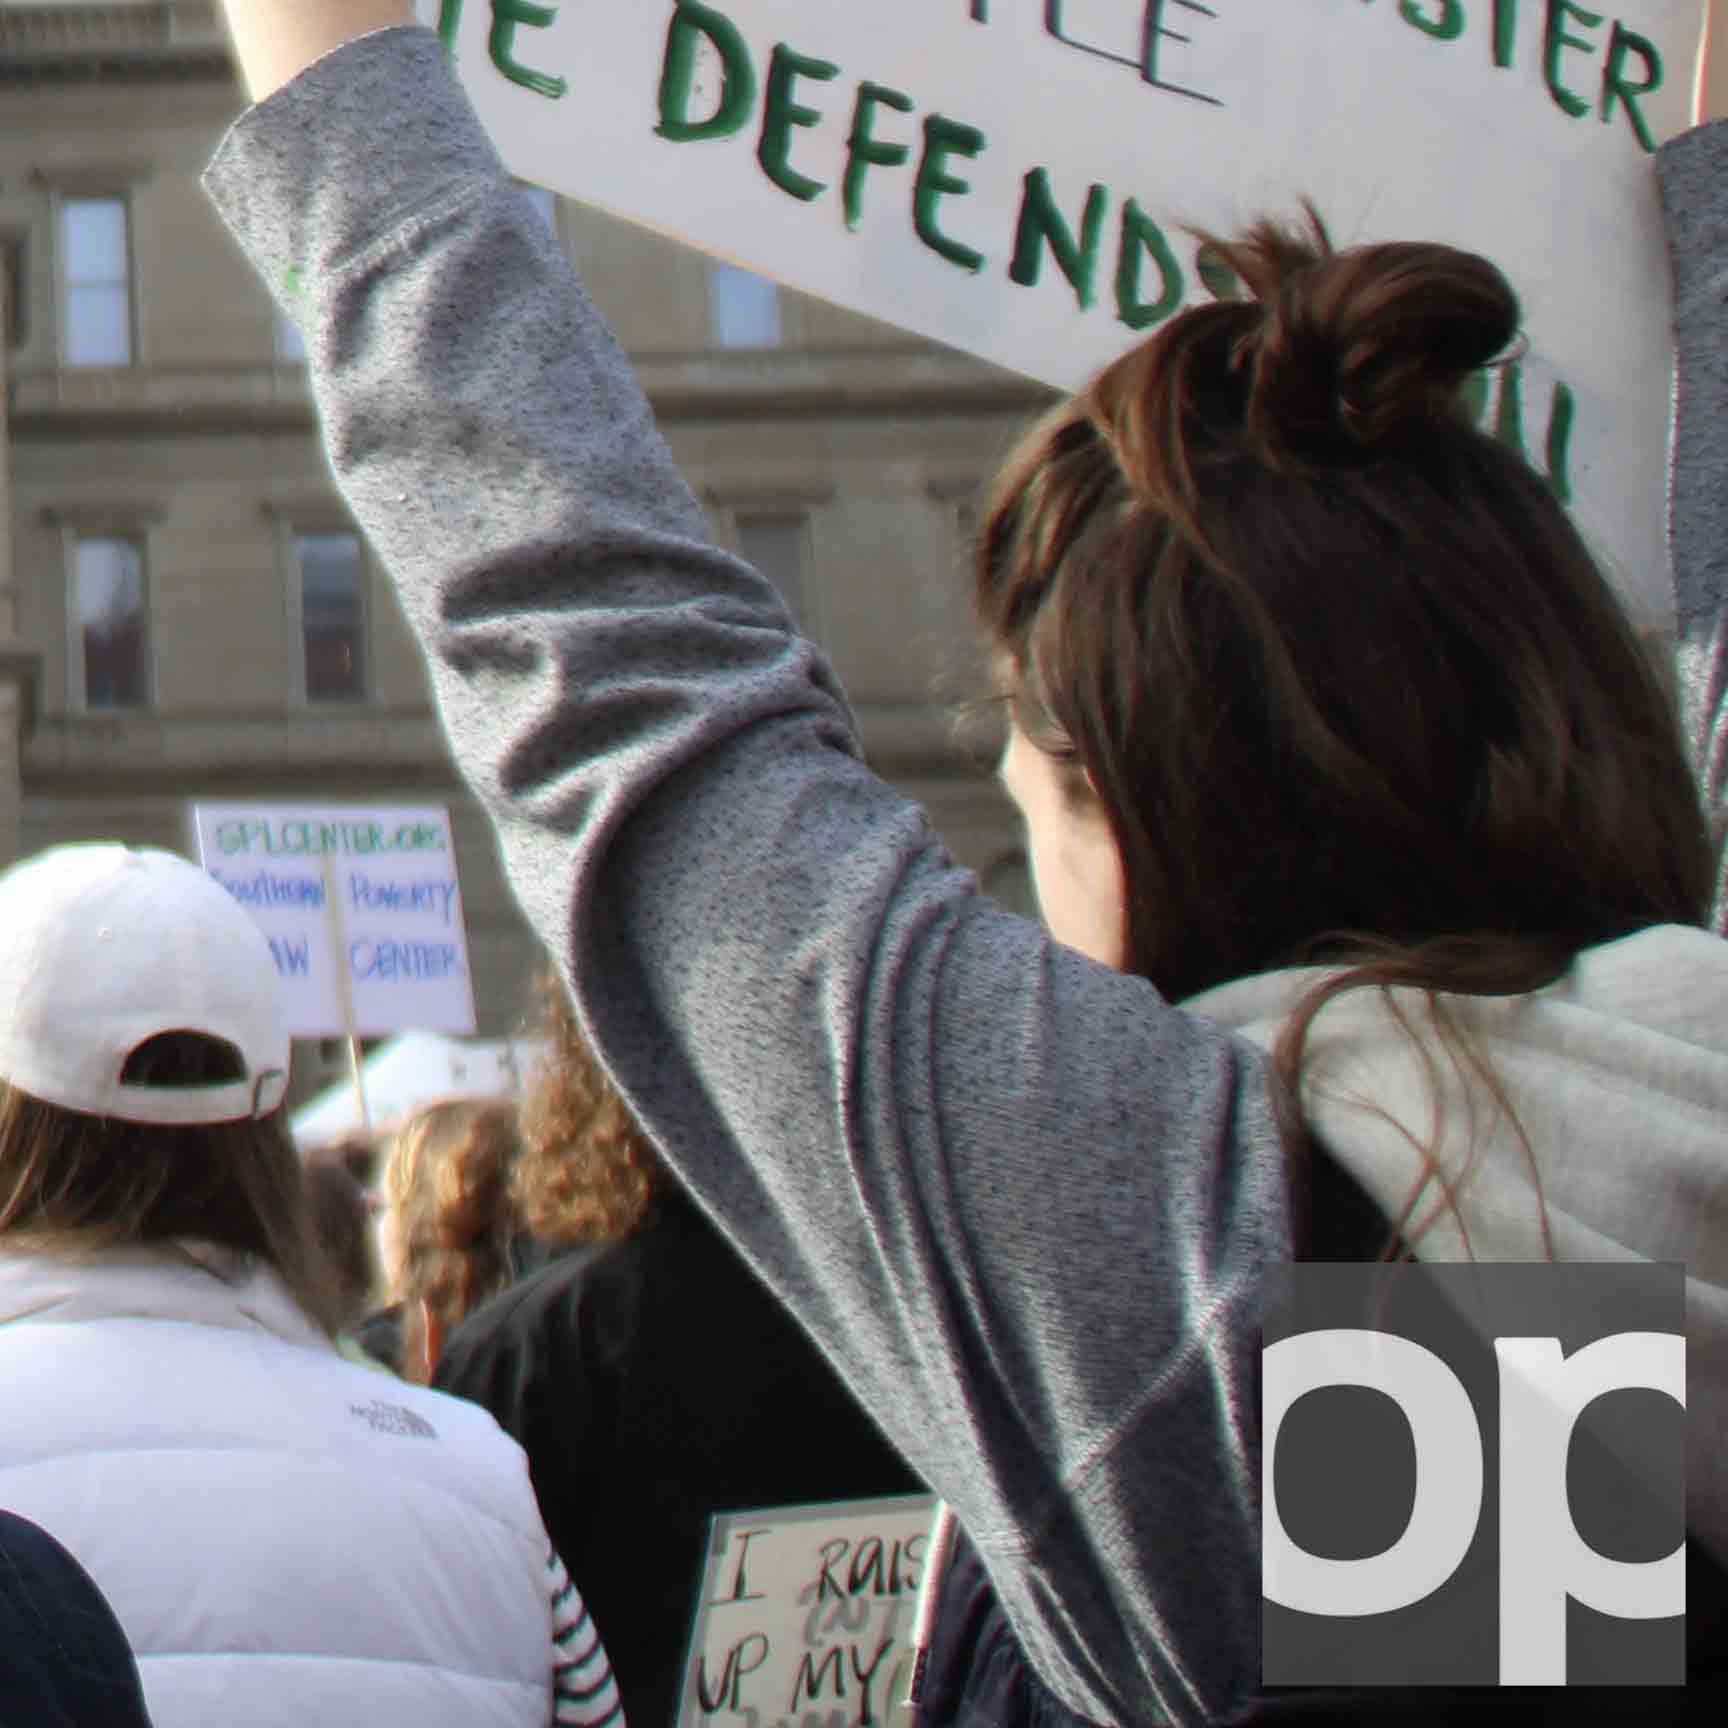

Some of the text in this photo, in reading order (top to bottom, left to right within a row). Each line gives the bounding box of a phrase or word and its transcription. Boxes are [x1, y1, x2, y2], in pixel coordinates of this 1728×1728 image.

[707, 1529, 772, 1607] I
[696, 1632, 895, 1728] UP MY
